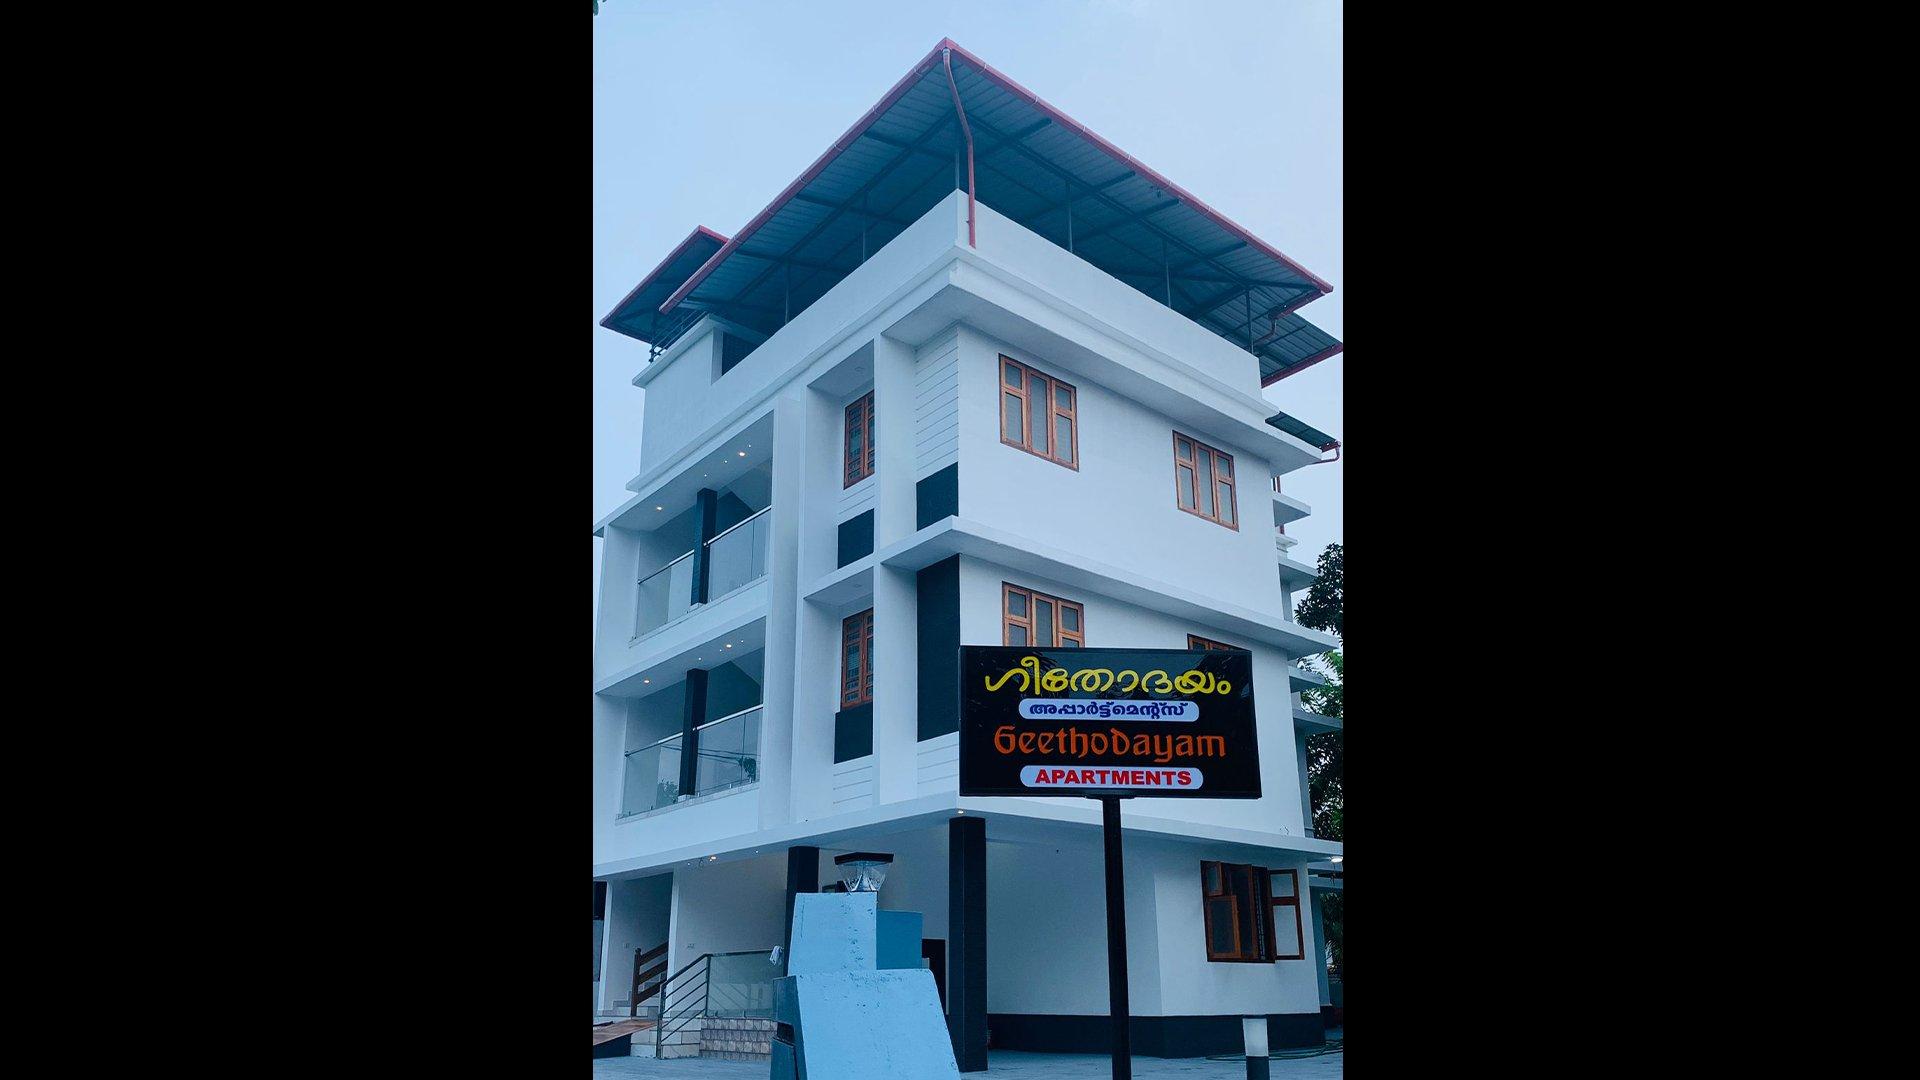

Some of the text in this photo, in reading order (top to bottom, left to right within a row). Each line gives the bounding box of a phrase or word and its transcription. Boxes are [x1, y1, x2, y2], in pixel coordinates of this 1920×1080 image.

[985, 656, 1232, 695] ഗീതോദയം
[994, 725, 1227, 763] Geethodayam
[1035, 769, 1192, 786] APARTMENTS
